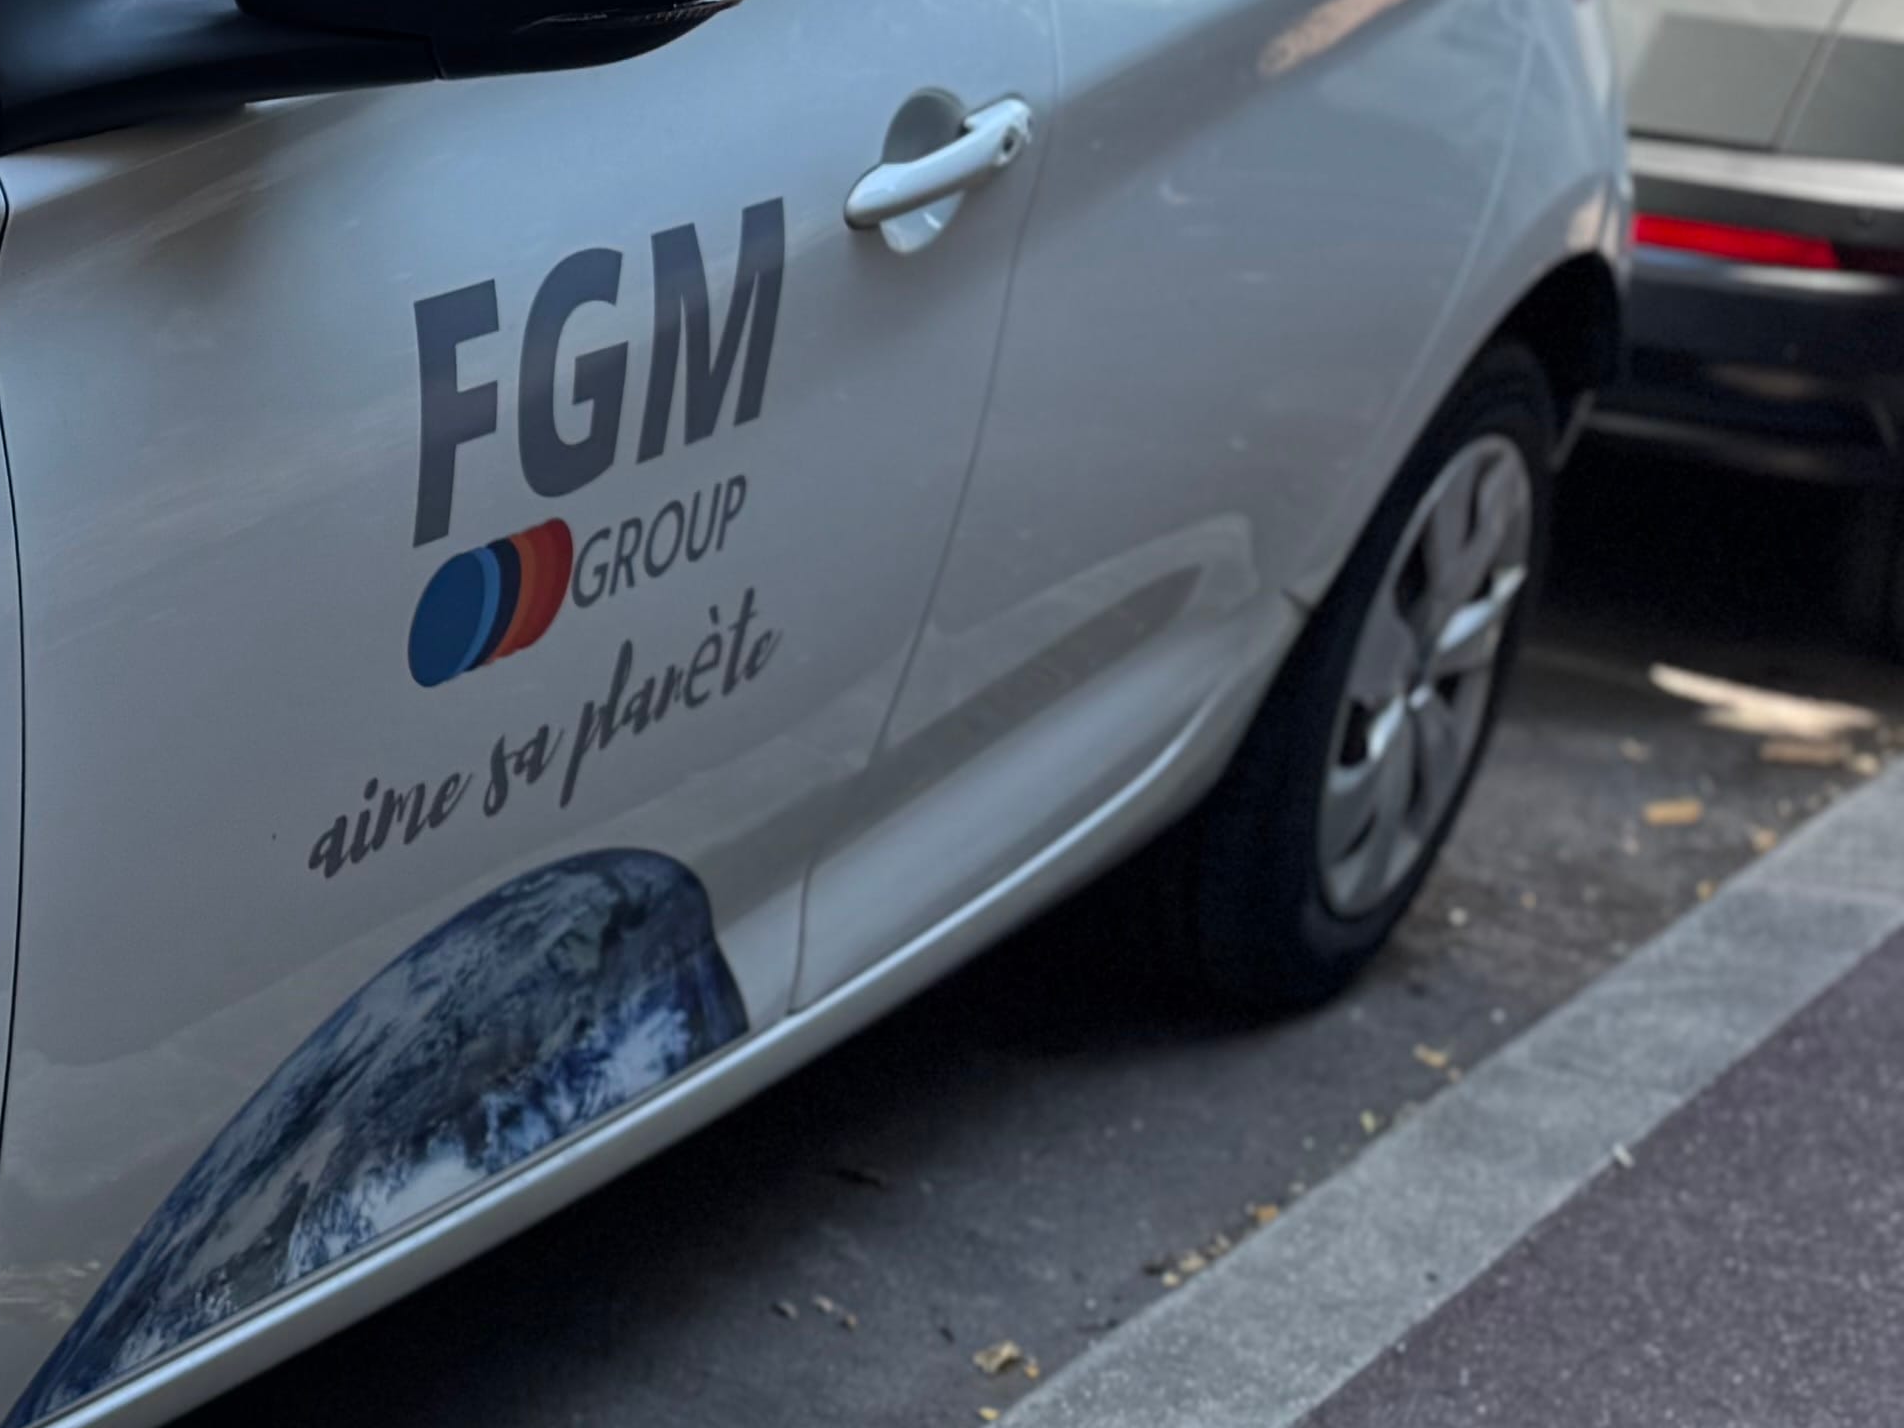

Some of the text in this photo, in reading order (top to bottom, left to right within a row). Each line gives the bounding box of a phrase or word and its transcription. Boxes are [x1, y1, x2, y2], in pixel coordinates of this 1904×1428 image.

[413, 197, 785, 548] FGM
[571, 475, 748, 609] GROUP
[308, 586, 784, 879] aime sa planète
